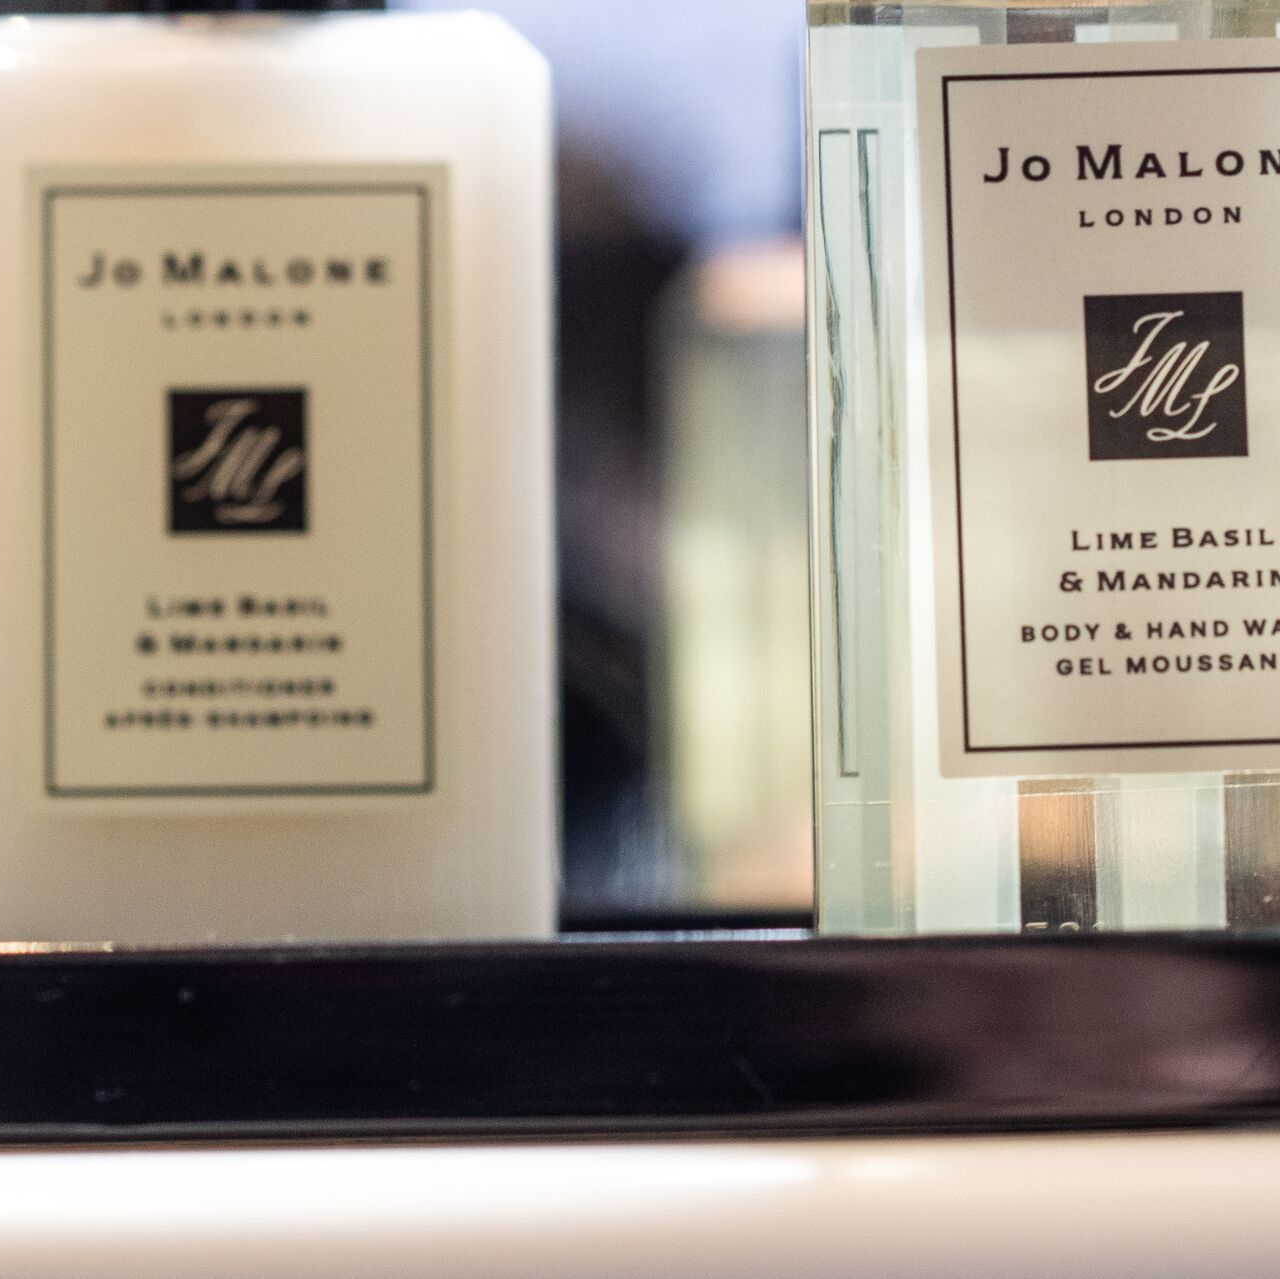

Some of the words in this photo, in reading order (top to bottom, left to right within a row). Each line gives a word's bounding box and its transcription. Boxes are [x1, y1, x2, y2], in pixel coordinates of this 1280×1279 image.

[983, 146, 1052, 184] JO
[1078, 206, 1242, 229] LONDON
[1071, 529, 1158, 552] LIME
[1171, 526, 1275, 549] BASIL
[1058, 570, 1083, 593] &
[1020, 623, 1101, 644] BODY
[1114, 622, 1132, 641] &
[1146, 619, 1230, 639] HAND
[1055, 657, 1112, 677] GEL
